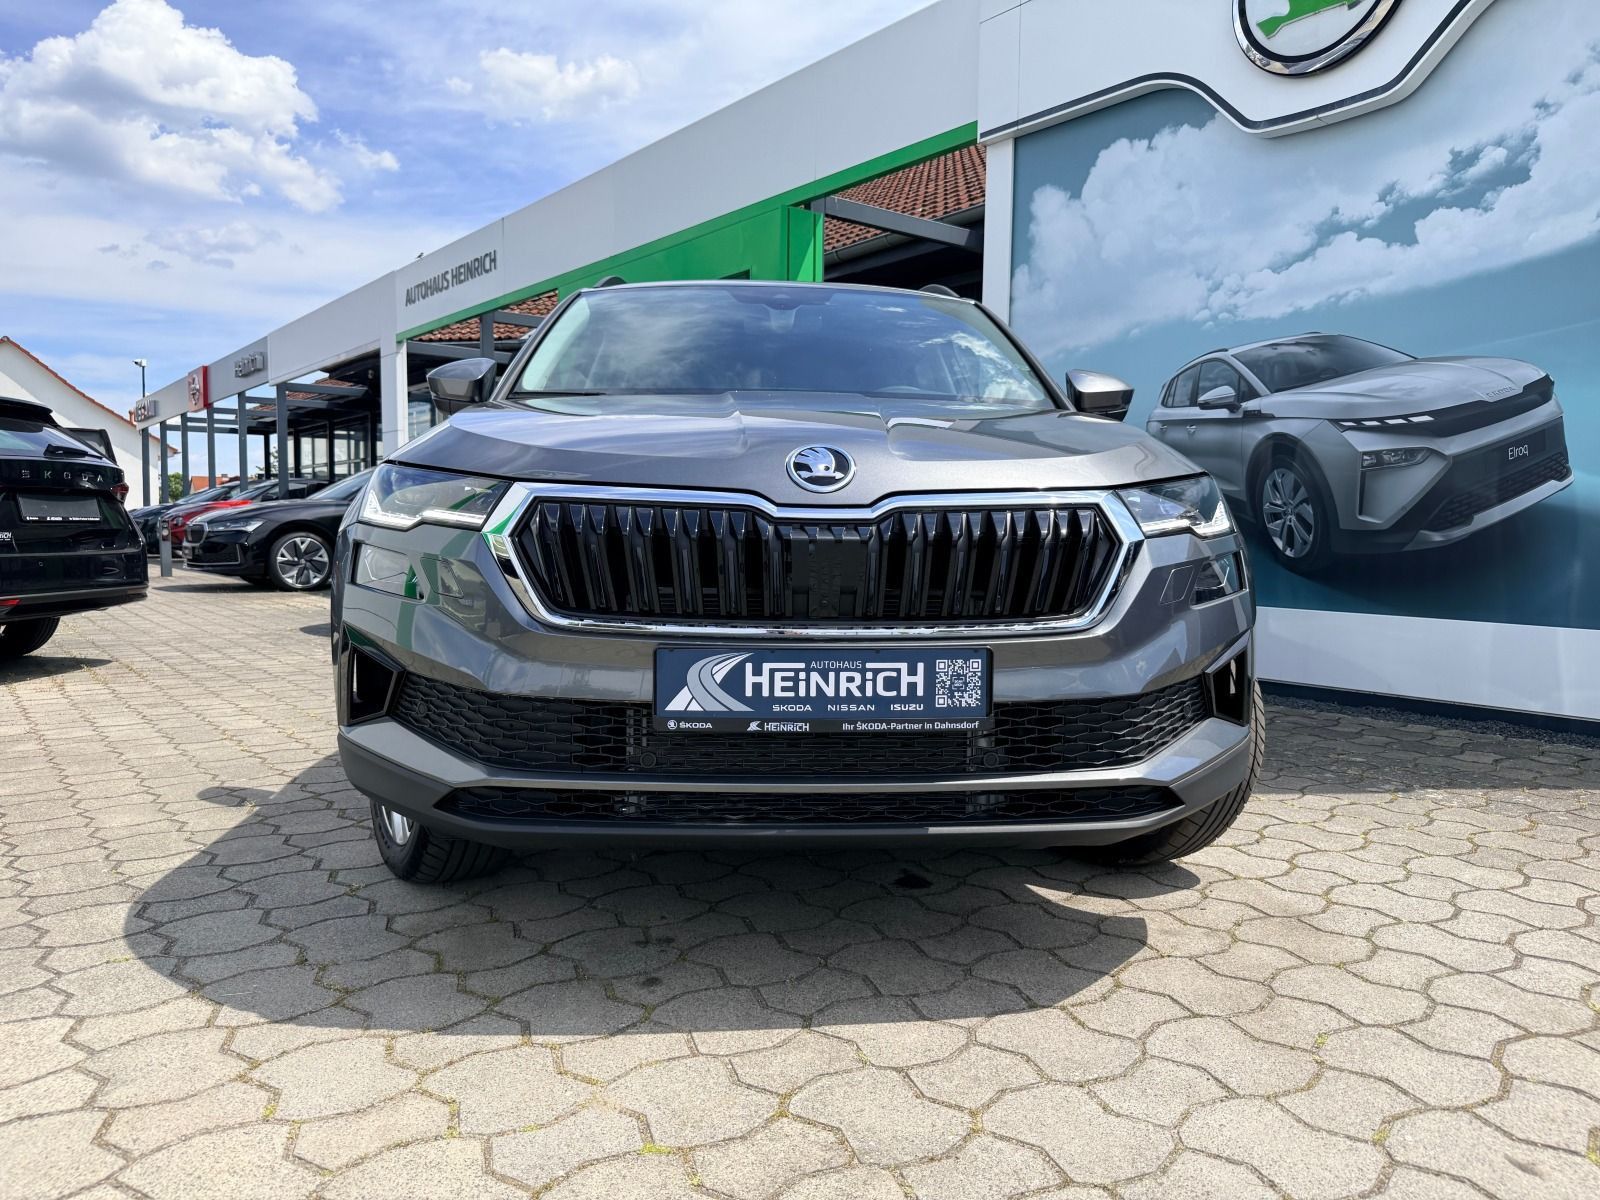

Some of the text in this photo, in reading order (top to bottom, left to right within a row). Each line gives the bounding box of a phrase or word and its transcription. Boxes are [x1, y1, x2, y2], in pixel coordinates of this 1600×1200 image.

[405, 249, 497, 307] AUTOHAUS HEINRICH
[1508, 444, 1529, 460] Elroq
[810, 660, 862, 669] AUTOHAUS
[890, 703, 924, 711] ISUZU
[842, 721, 980, 731] Ihr ŠKODA-Partner in Dahnsdorf
